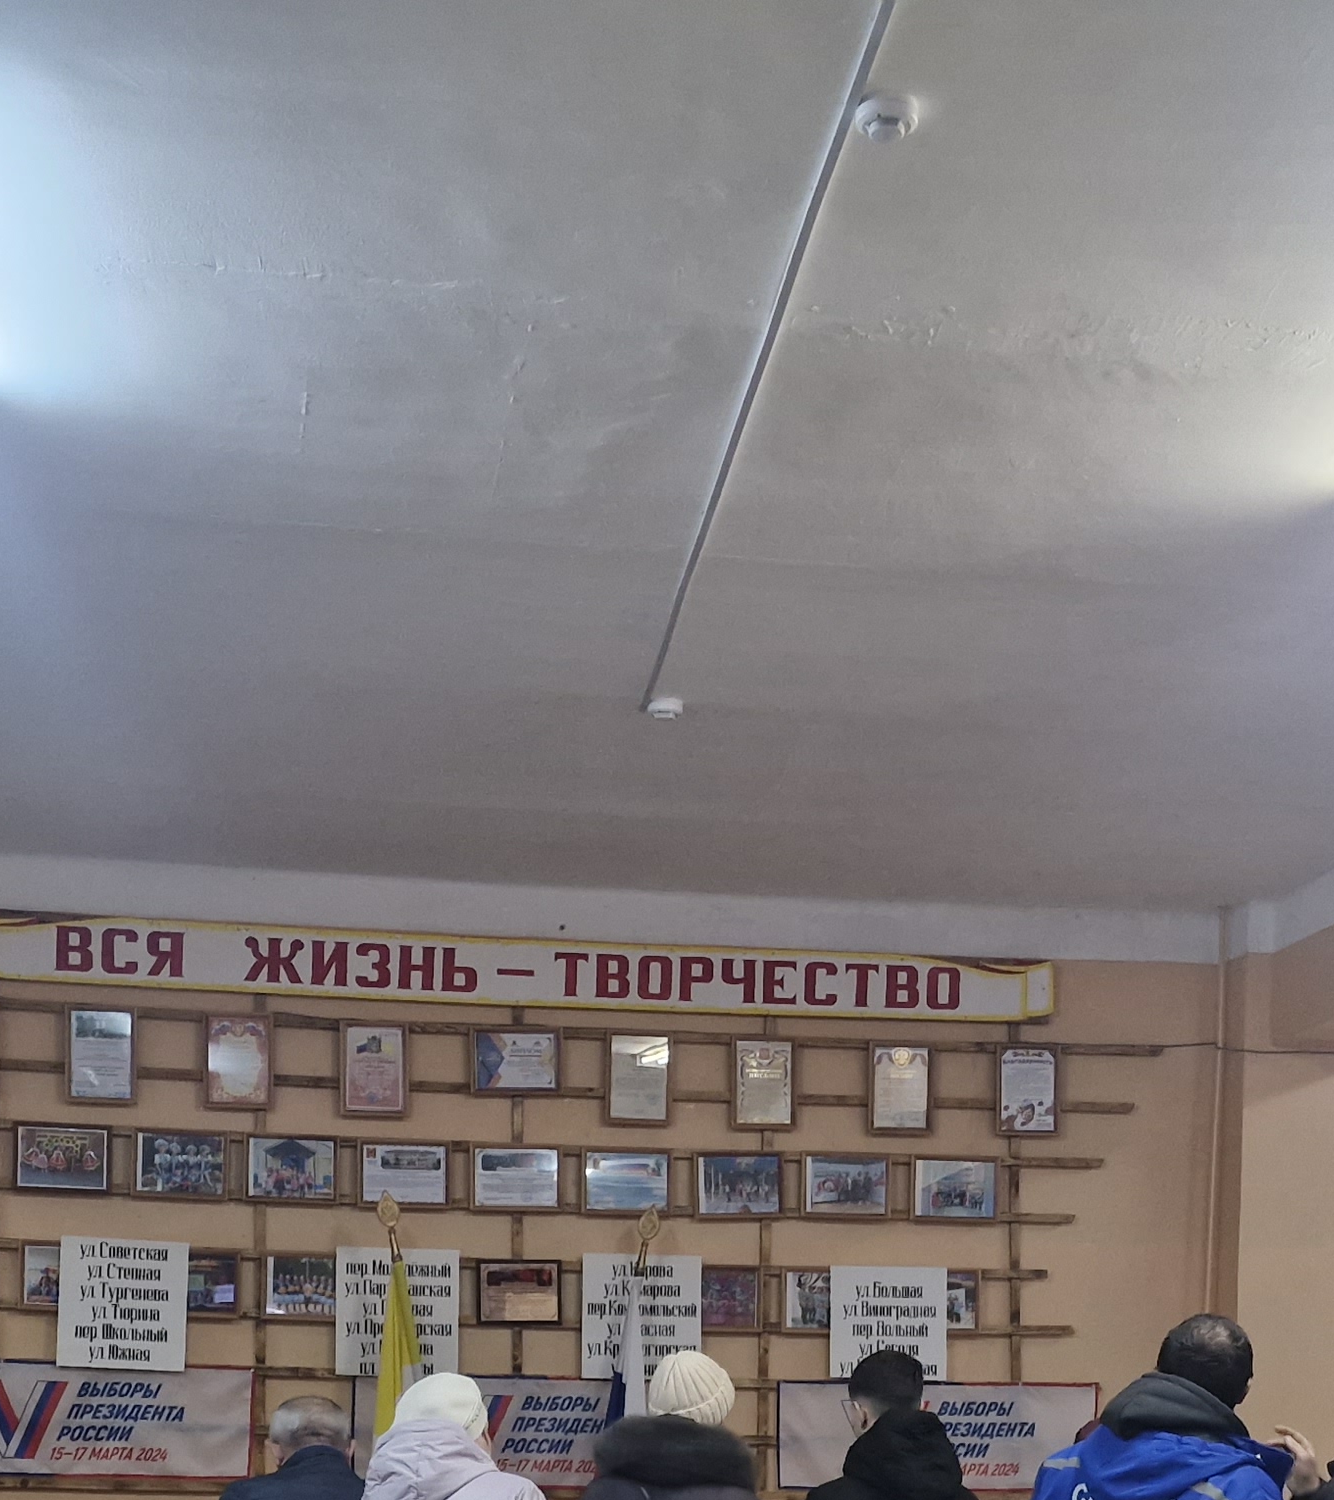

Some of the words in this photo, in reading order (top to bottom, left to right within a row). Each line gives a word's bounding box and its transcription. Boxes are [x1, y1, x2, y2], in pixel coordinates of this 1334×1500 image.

[54, 925, 186, 978] ВСЯ
[244, 935, 478, 993] ЖИЗНЬ
[554, 951, 961, 1011] ТВОРЧЕСТВО
[99, 1241, 169, 1262] Советская
[107, 1262, 161, 1281] Степная
[100, 1281, 169, 1303] Тургенева
[363, 1279, 452, 1298] Паранская
[873, 1281, 923, 1299] Большая
[111, 1303, 161, 1324] Тюрина
[861, 1300, 937, 1321] Виноградная
[102, 1323, 168, 1343] Школьный
[876, 1320, 929, 1338] Вольный
[108, 1343, 151, 1362] Южная
[77, 1381, 163, 1399] ВЫБОРЫ
[67, 1403, 185, 1422] ПРЕЗИДЕНТА
[521, 1395, 601, 1413] ВЫБОРЫ
[937, 1401, 1015, 1417] ВЫБОРЫ
[56, 1425, 134, 1442] РОССИИ
[511, 1416, 606, 1436] ПРЕЗИДЕН
[943, 1422, 1036, 1439] РЕЗИДЕНТА
[89, 1447, 134, 1462] МАРТА
[135, 1448, 169, 1462] 2024
[501, 1438, 574, 1454] РОССИИ
[531, 1459, 573, 1473] МАРТА
[575, 1459, 597, 1473] 202
[991, 1463, 1019, 1477] 2024
